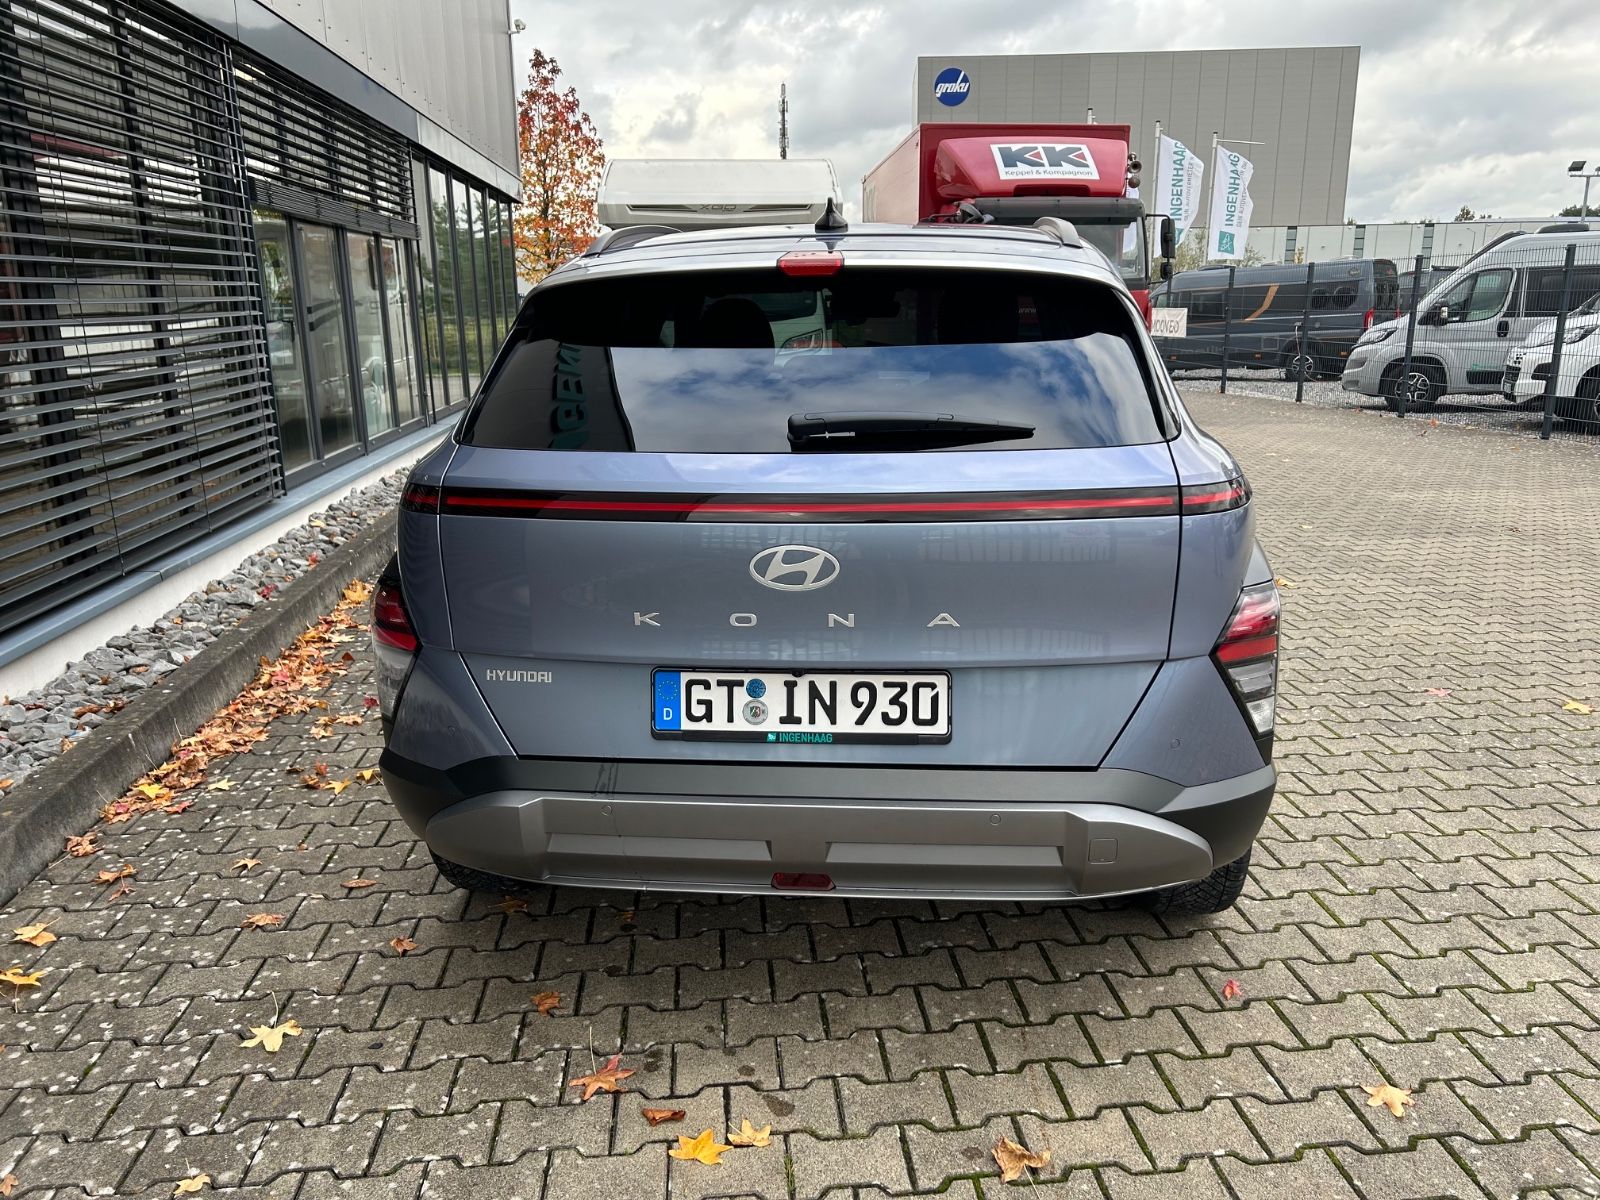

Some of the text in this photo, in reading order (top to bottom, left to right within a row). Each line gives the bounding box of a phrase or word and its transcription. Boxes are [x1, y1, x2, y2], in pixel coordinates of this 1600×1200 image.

[935, 70, 970, 98] groku
[998, 146, 1090, 168] KK
[633, 611, 961, 628] KONA
[486, 669, 552, 683] HYUNDAI
[684, 678, 745, 723] GT
[779, 680, 837, 725] IN
[850, 681, 939, 727] 930
[662, 707, 673, 721] D
[779, 732, 833, 743] INGENHAAG
